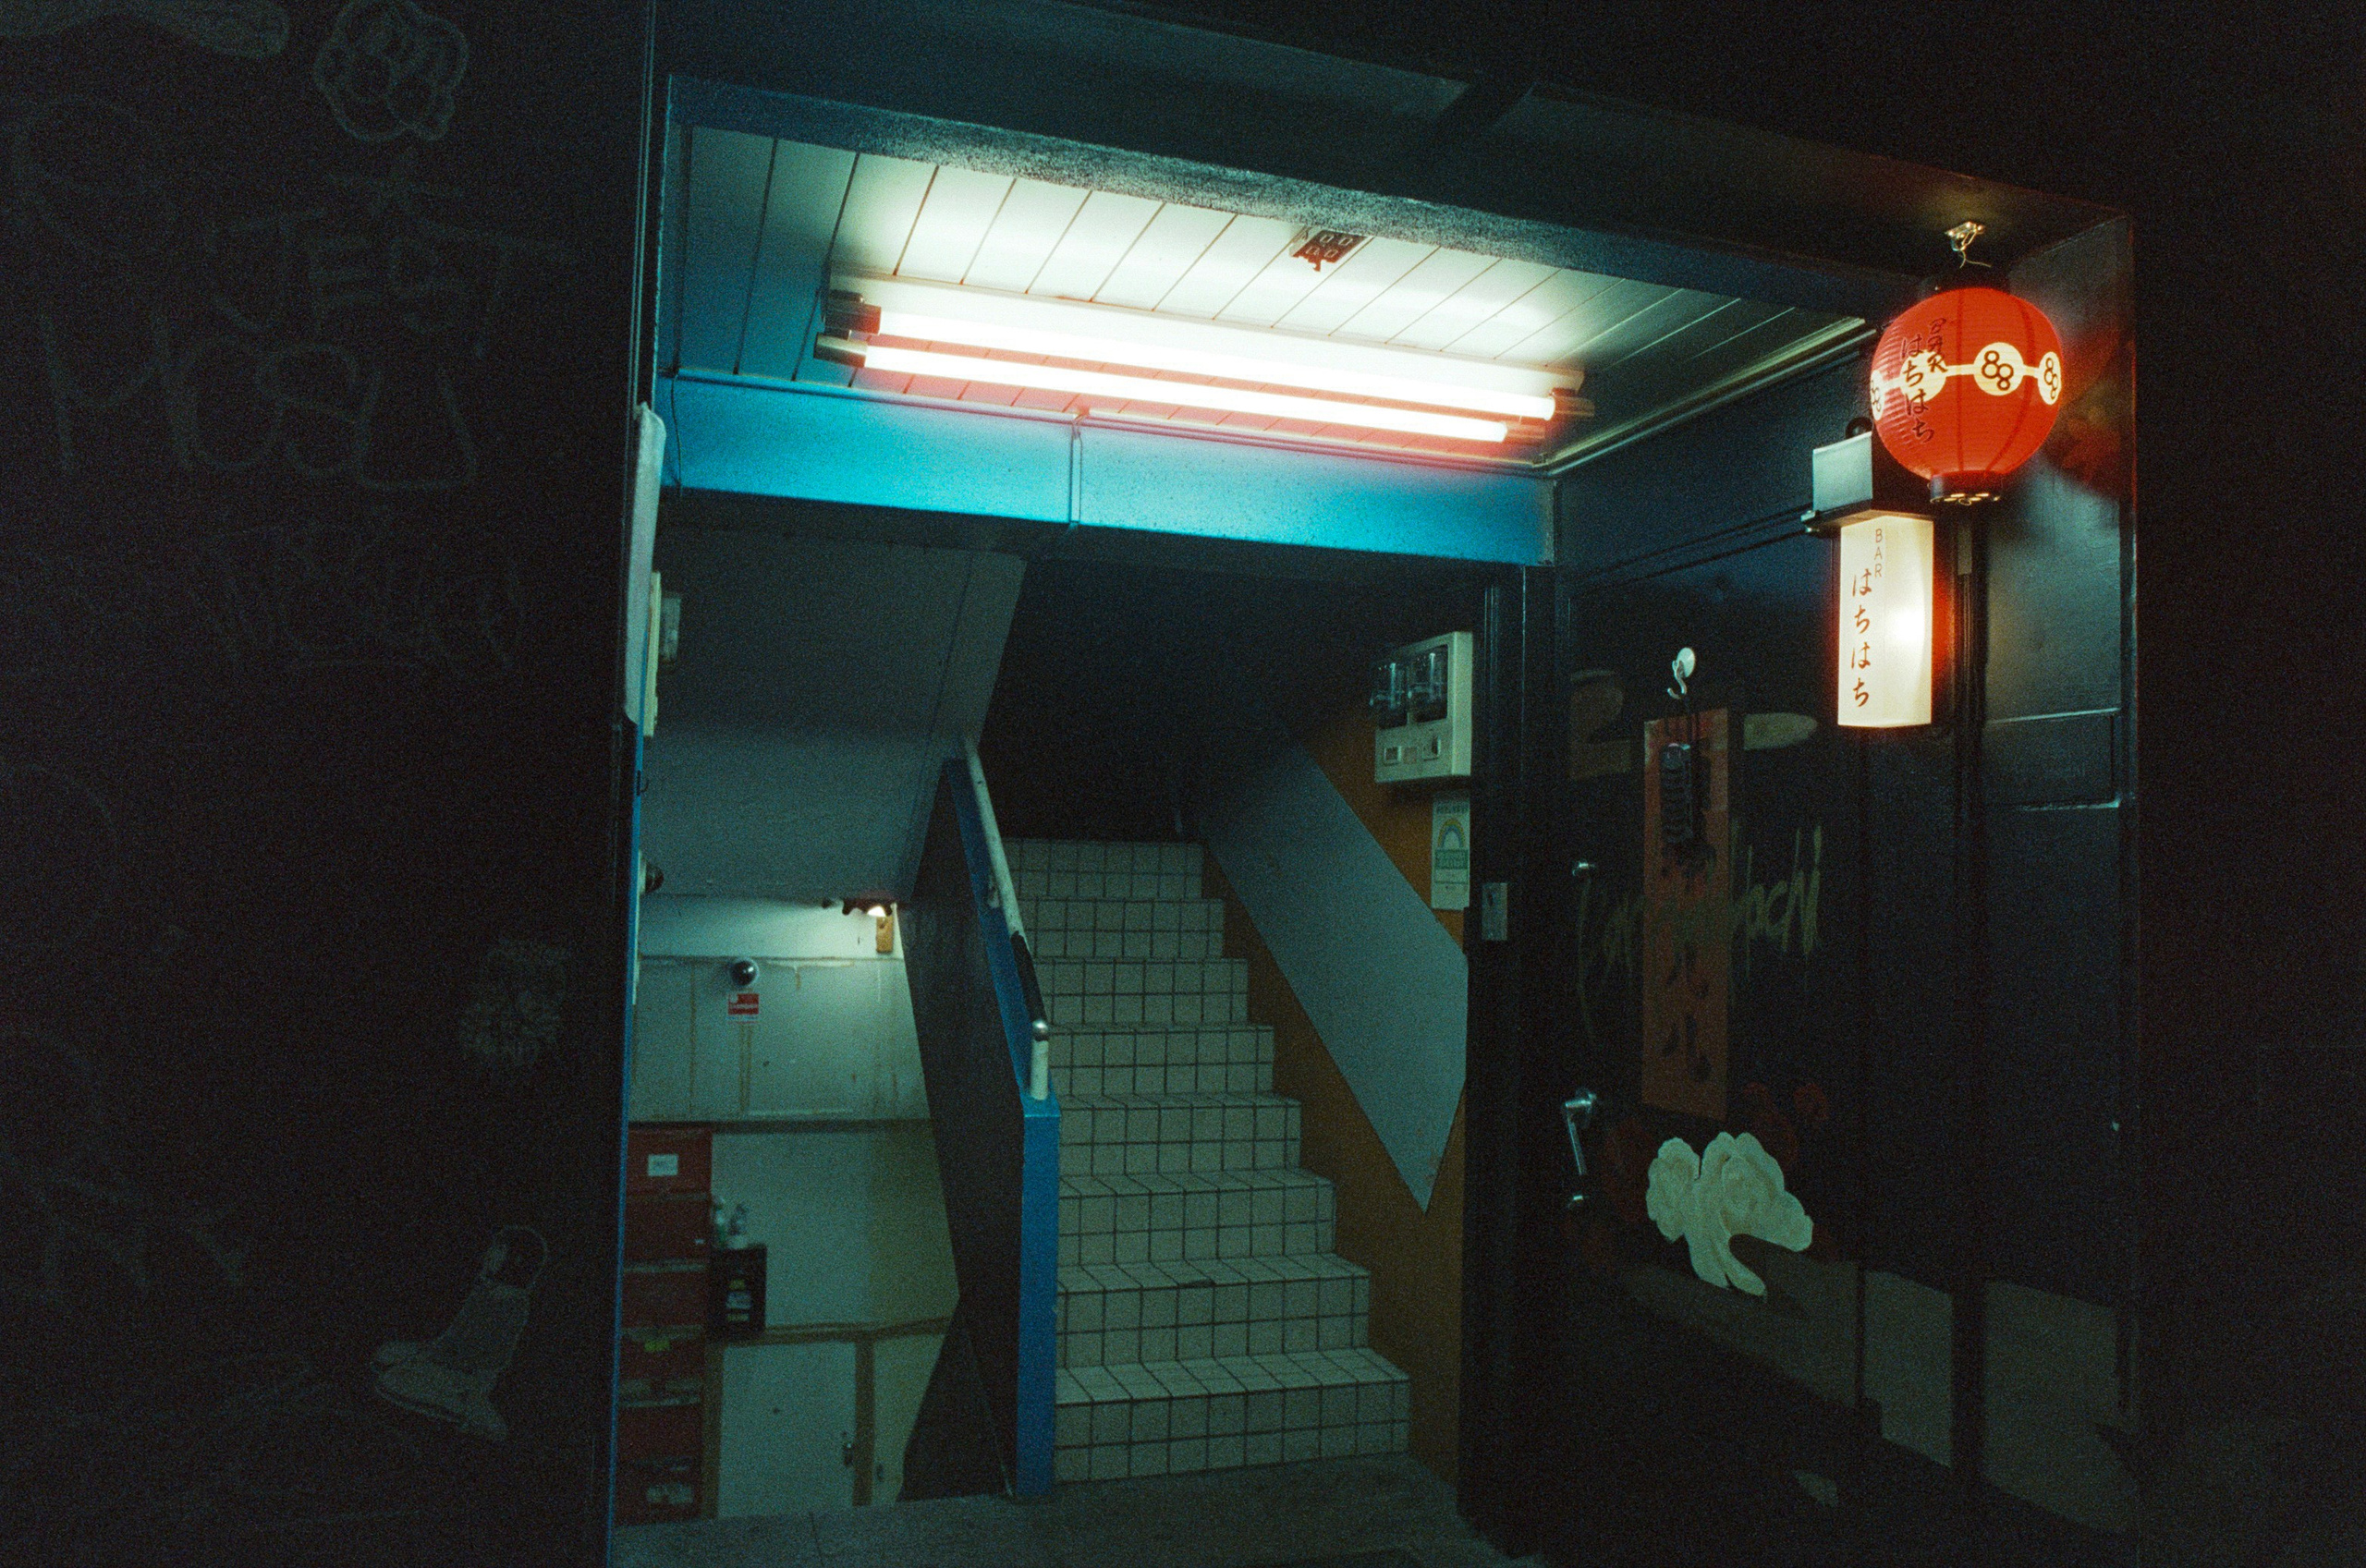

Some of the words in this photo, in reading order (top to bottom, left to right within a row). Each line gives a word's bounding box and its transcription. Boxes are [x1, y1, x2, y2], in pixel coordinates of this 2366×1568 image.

[1927, 317, 1948, 373] BAR
[1900, 334, 1935, 444] はちはち
[1873, 528, 1884, 577] BAR
[1850, 568, 1872, 708] はちはち
